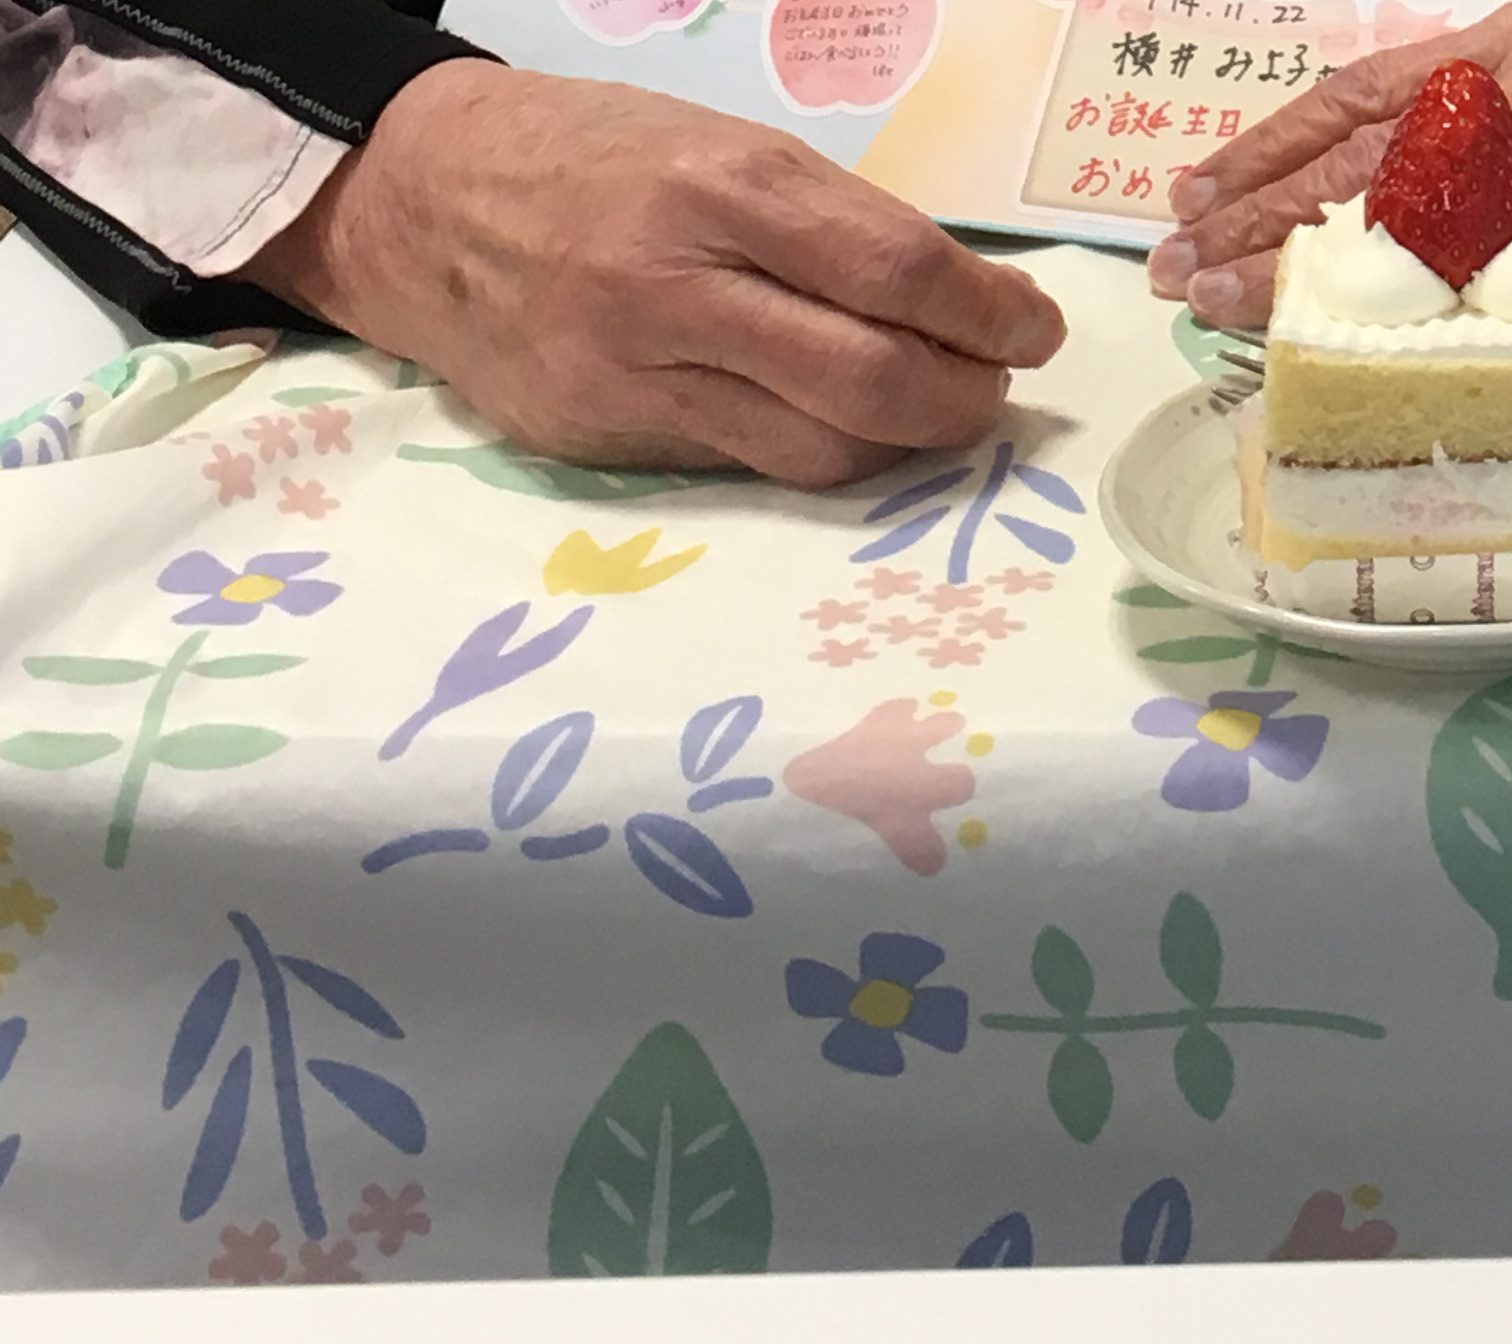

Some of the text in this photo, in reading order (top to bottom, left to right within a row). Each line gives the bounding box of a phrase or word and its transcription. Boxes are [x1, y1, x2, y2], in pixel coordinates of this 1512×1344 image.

[1112, 31, 1199, 79] 横井
[1065, 92, 1242, 138] お誕生日
